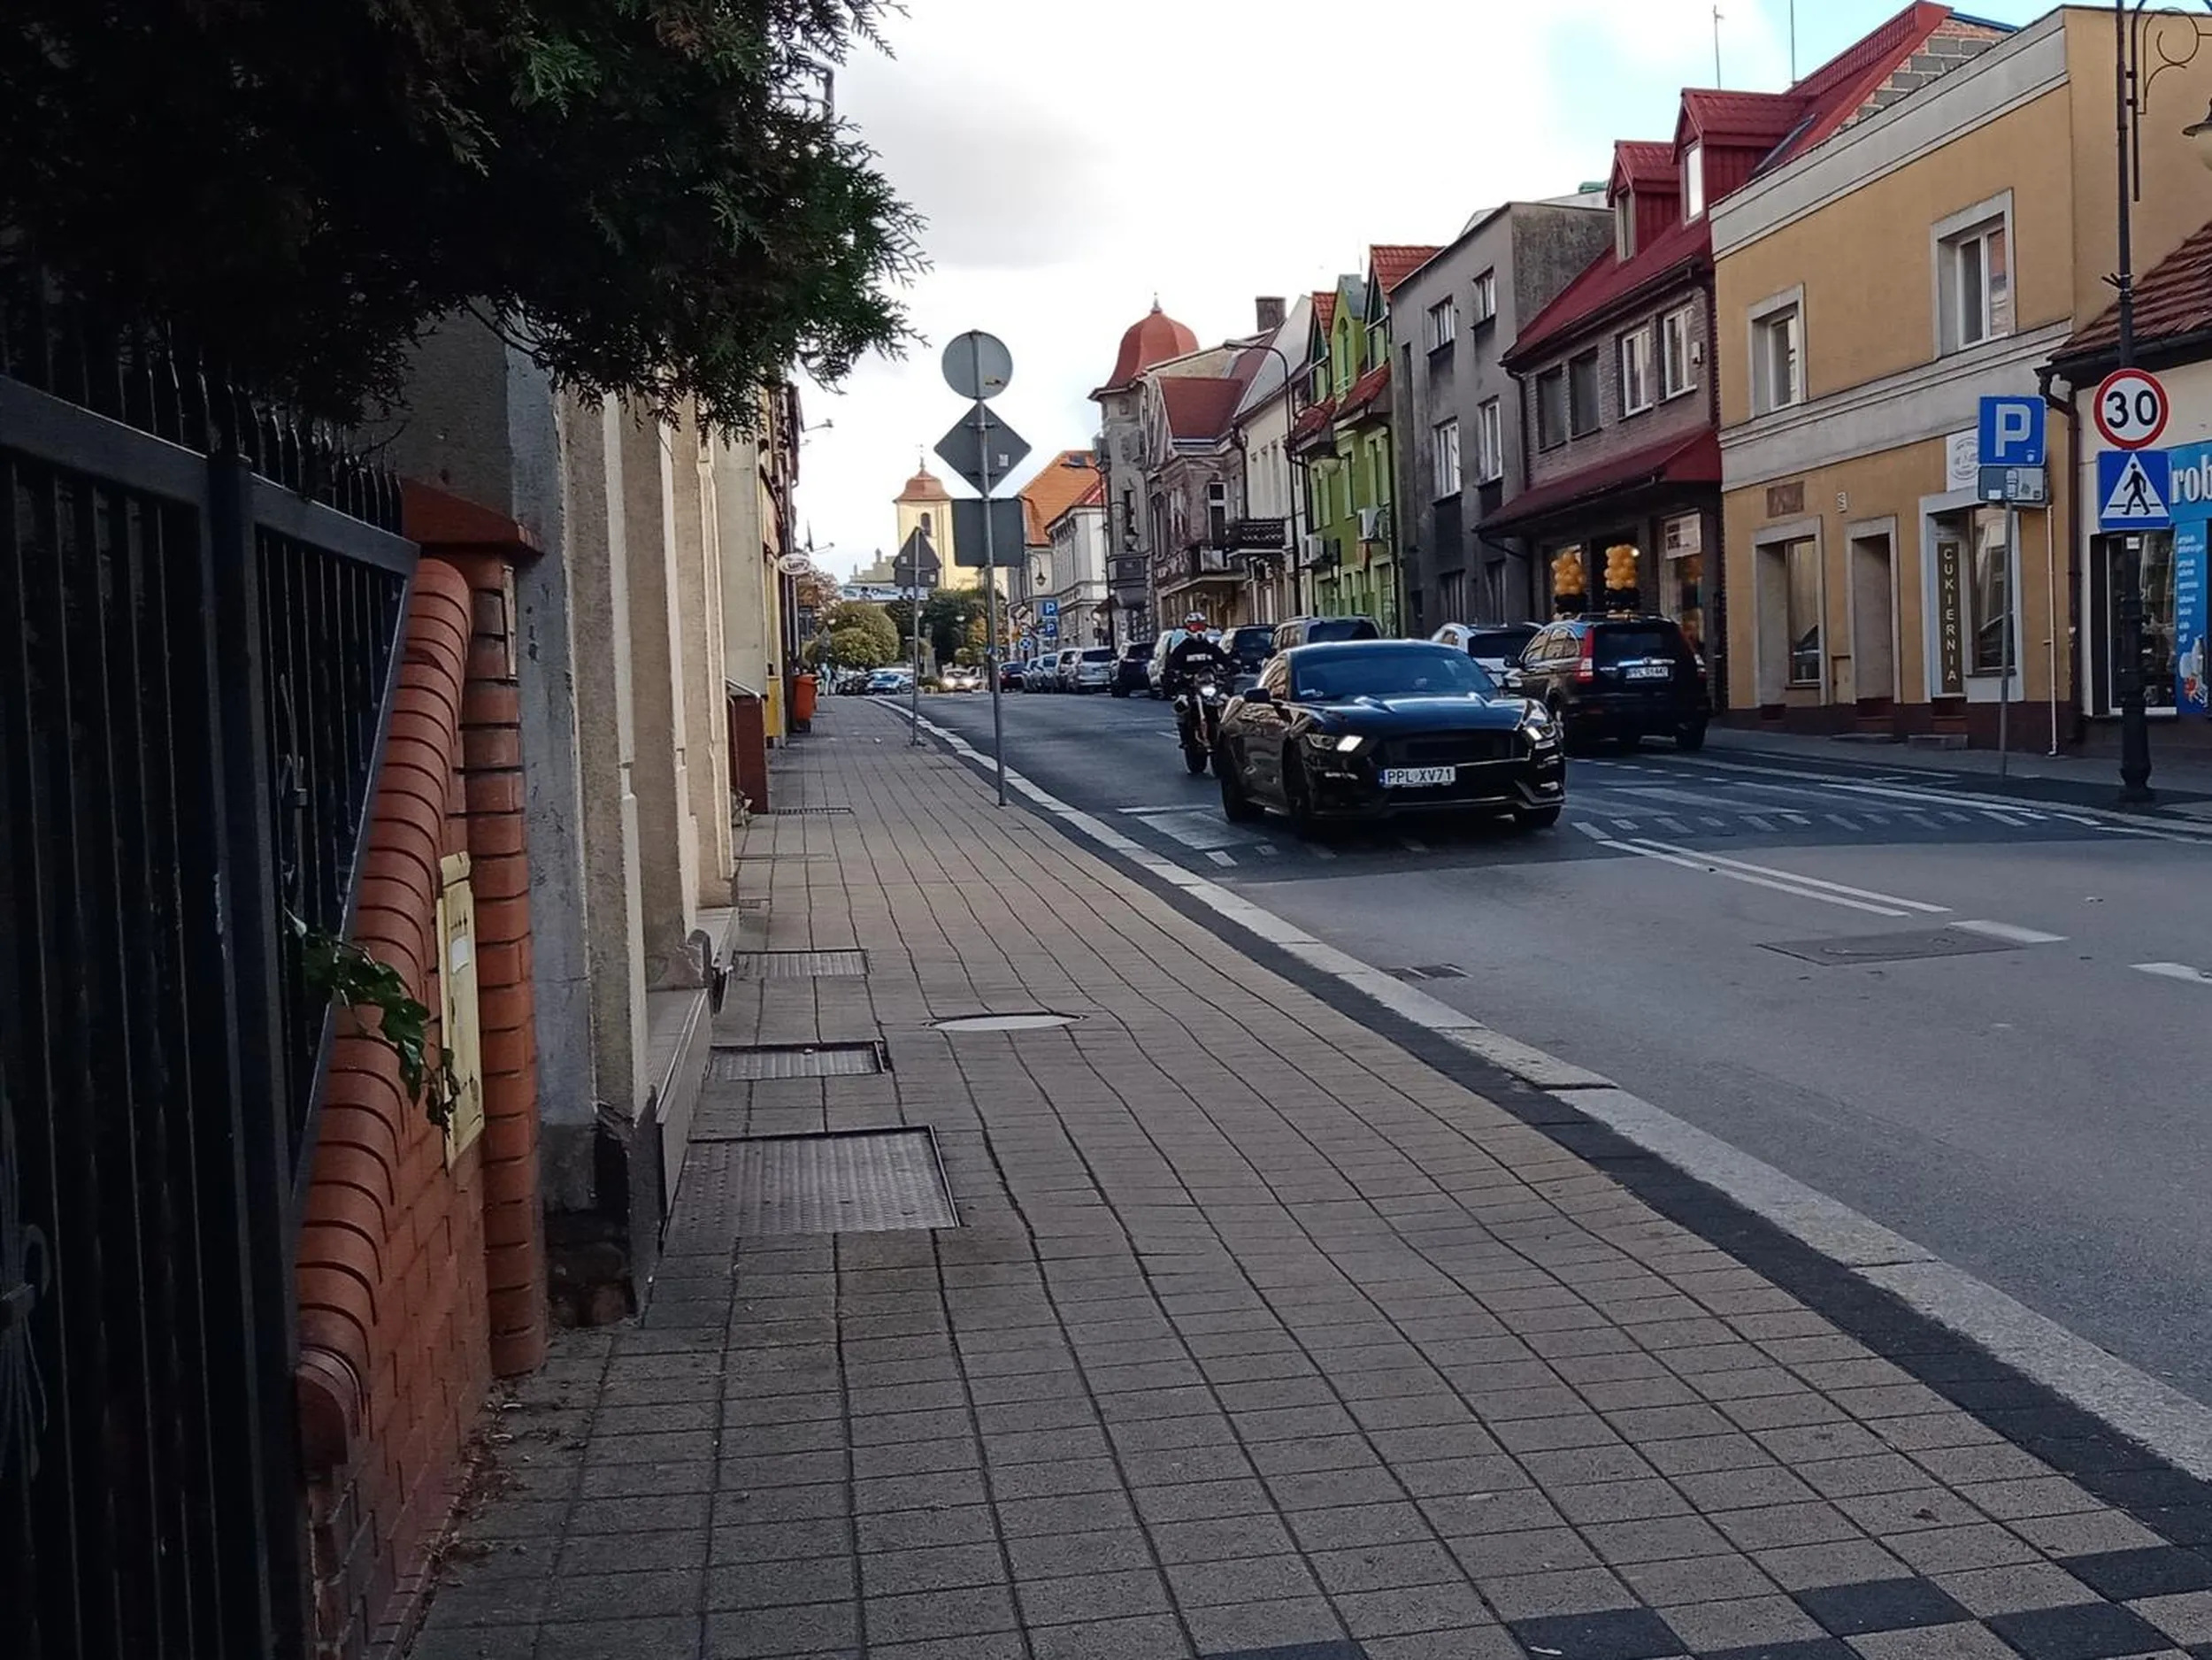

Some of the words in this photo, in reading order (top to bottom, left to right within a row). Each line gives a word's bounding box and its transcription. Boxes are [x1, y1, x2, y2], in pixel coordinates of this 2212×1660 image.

[1994, 403, 2032, 457] P
[2106, 389, 2158, 429] 30
[1943, 548, 1957, 681] CUKIERNIA
[1387, 770, 1414, 783] PPL
[1419, 768, 1451, 781] XV71
